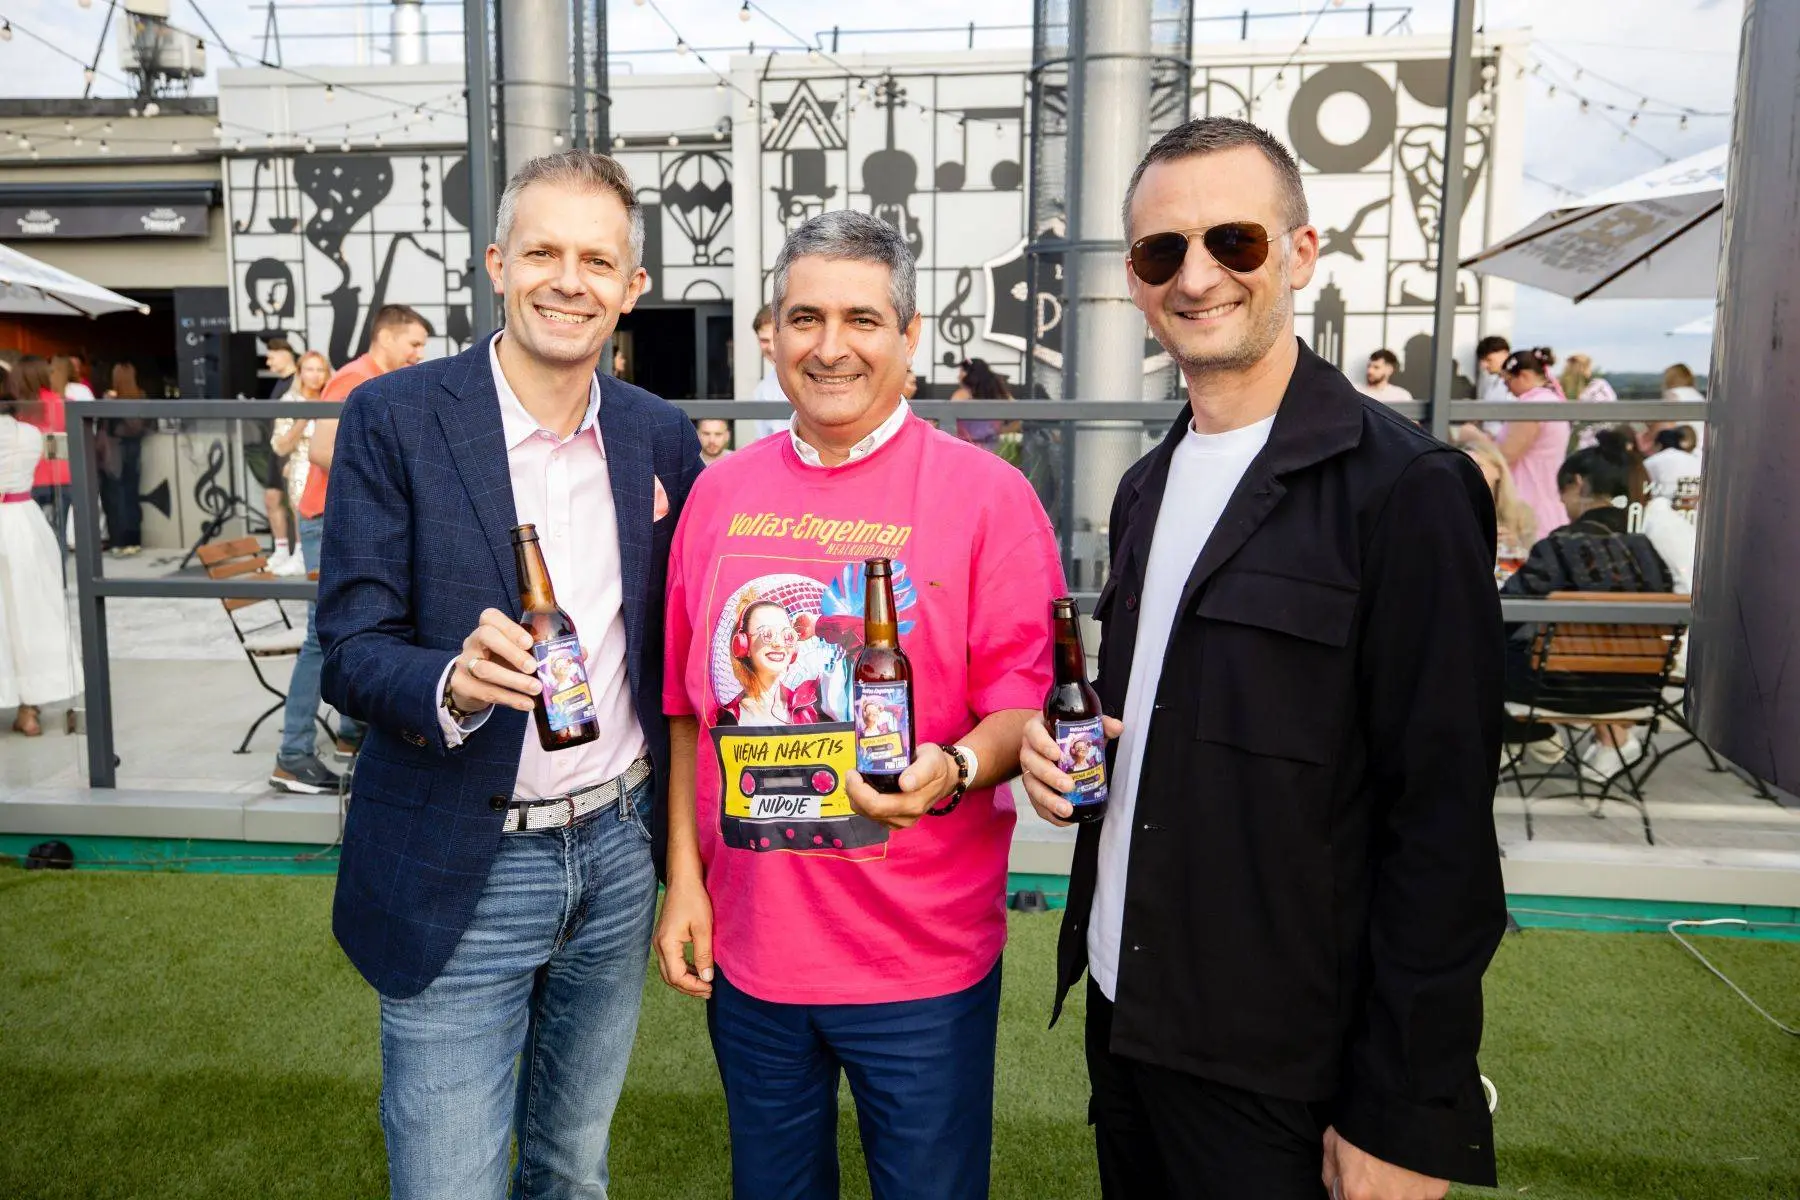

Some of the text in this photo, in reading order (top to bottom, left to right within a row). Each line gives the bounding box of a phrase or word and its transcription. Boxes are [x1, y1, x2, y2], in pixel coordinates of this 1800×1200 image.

[727, 512, 912, 546] Volfas-Engelman
[733, 742, 769, 762] VIENA
[774, 738, 844, 762] NAKTIS
[757, 796, 811, 817] NIDOJE
